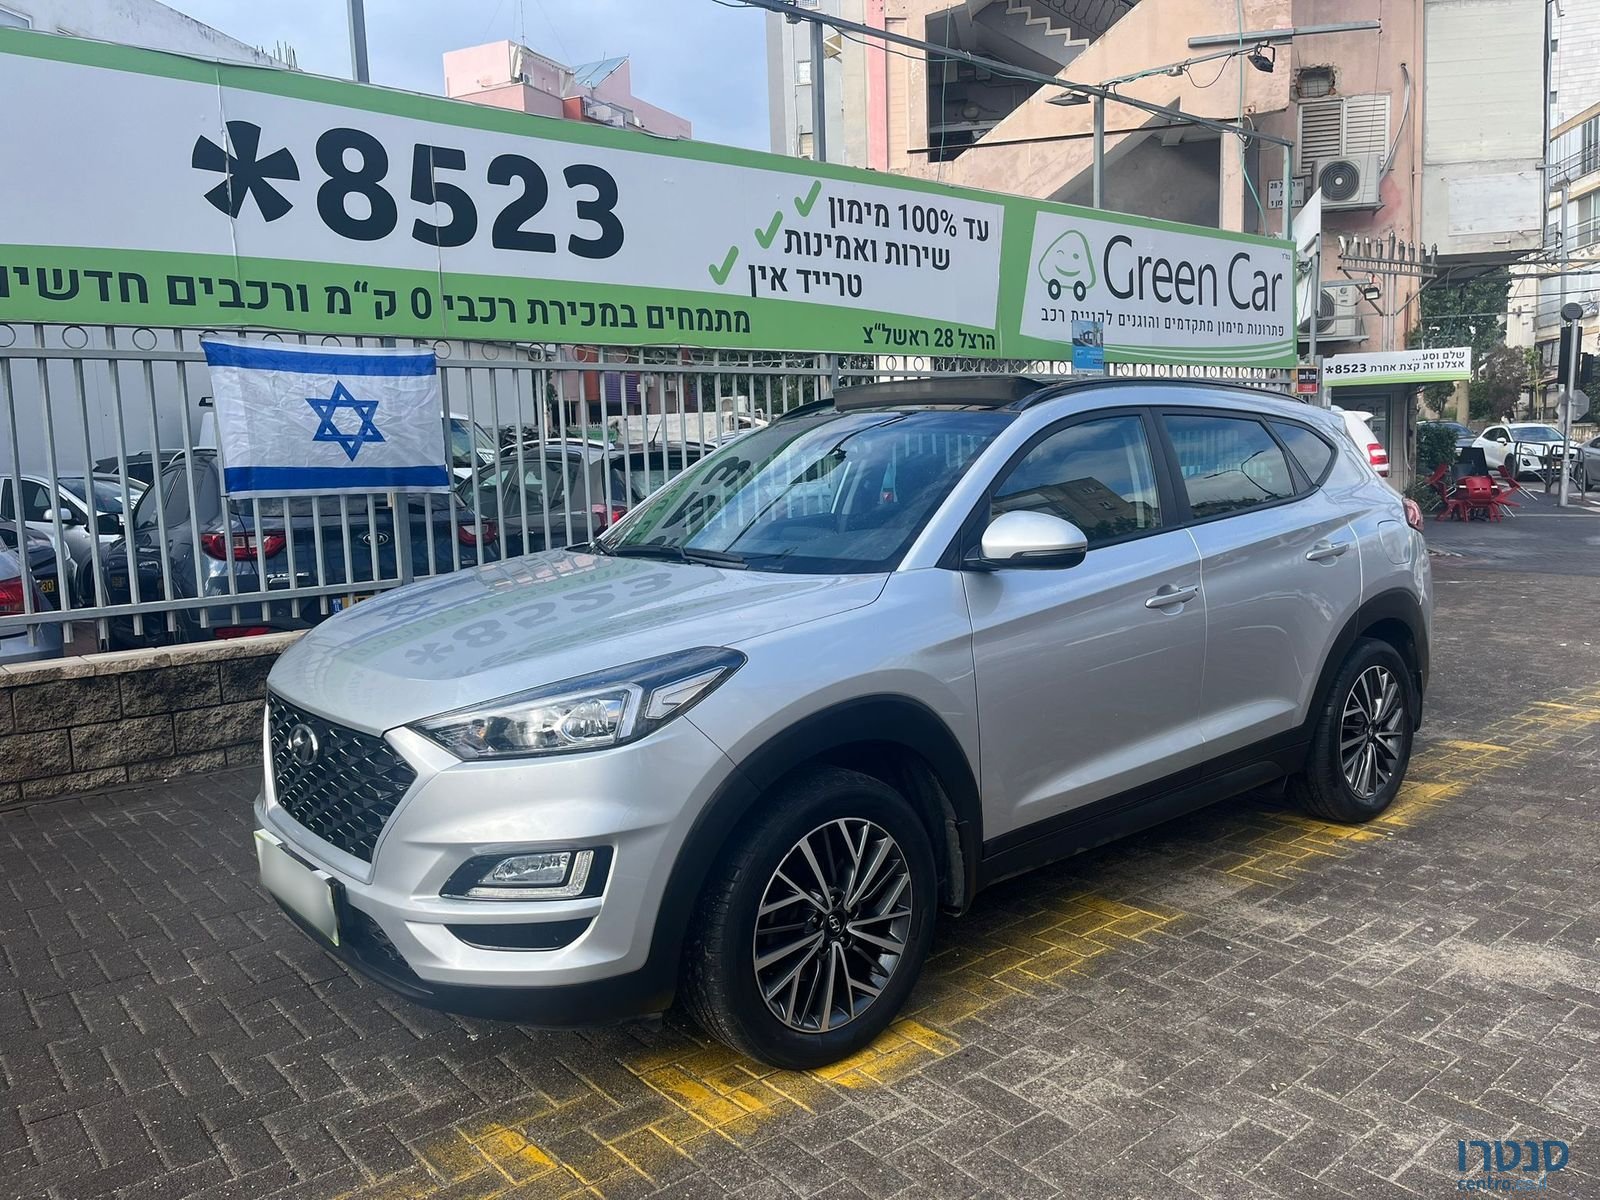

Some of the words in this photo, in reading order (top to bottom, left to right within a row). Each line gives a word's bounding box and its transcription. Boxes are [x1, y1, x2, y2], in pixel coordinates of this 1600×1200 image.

[828, 196, 889, 229] מימון
[898, 203, 957, 238] 100%
[963, 217, 989, 242] עד
[784, 229, 877, 263] ואמינות
[885, 241, 950, 271] שירות
[748, 264, 788, 298] אין
[796, 269, 862, 298] טרייד
[1103, 234, 1217, 307] Green
[1227, 252, 1283, 312] Car
[166, 274, 310, 313] ורכבים
[410, 286, 432, 320] 0
[443, 294, 517, 324] רכבי
[527, 298, 638, 329] במכירת
[647, 305, 751, 334] מתמחים
[1041, 307, 1065, 322] רכב
[1118, 313, 1160, 328] והוגנים
[934, 327, 954, 348] 28
[1164, 317, 1214, 334] מתקדמים
[1217, 321, 1244, 336] מימון
[1247, 323, 1284, 337] פתרונות
[958, 329, 996, 350] הרצל
[1399, 362, 1420, 372] קצת
[1423, 362, 1434, 370] זה
[1437, 360, 1465, 369] אצלנו
[1442, 350, 1465, 359] שלם
[1370, 364, 1396, 372] אחרת
